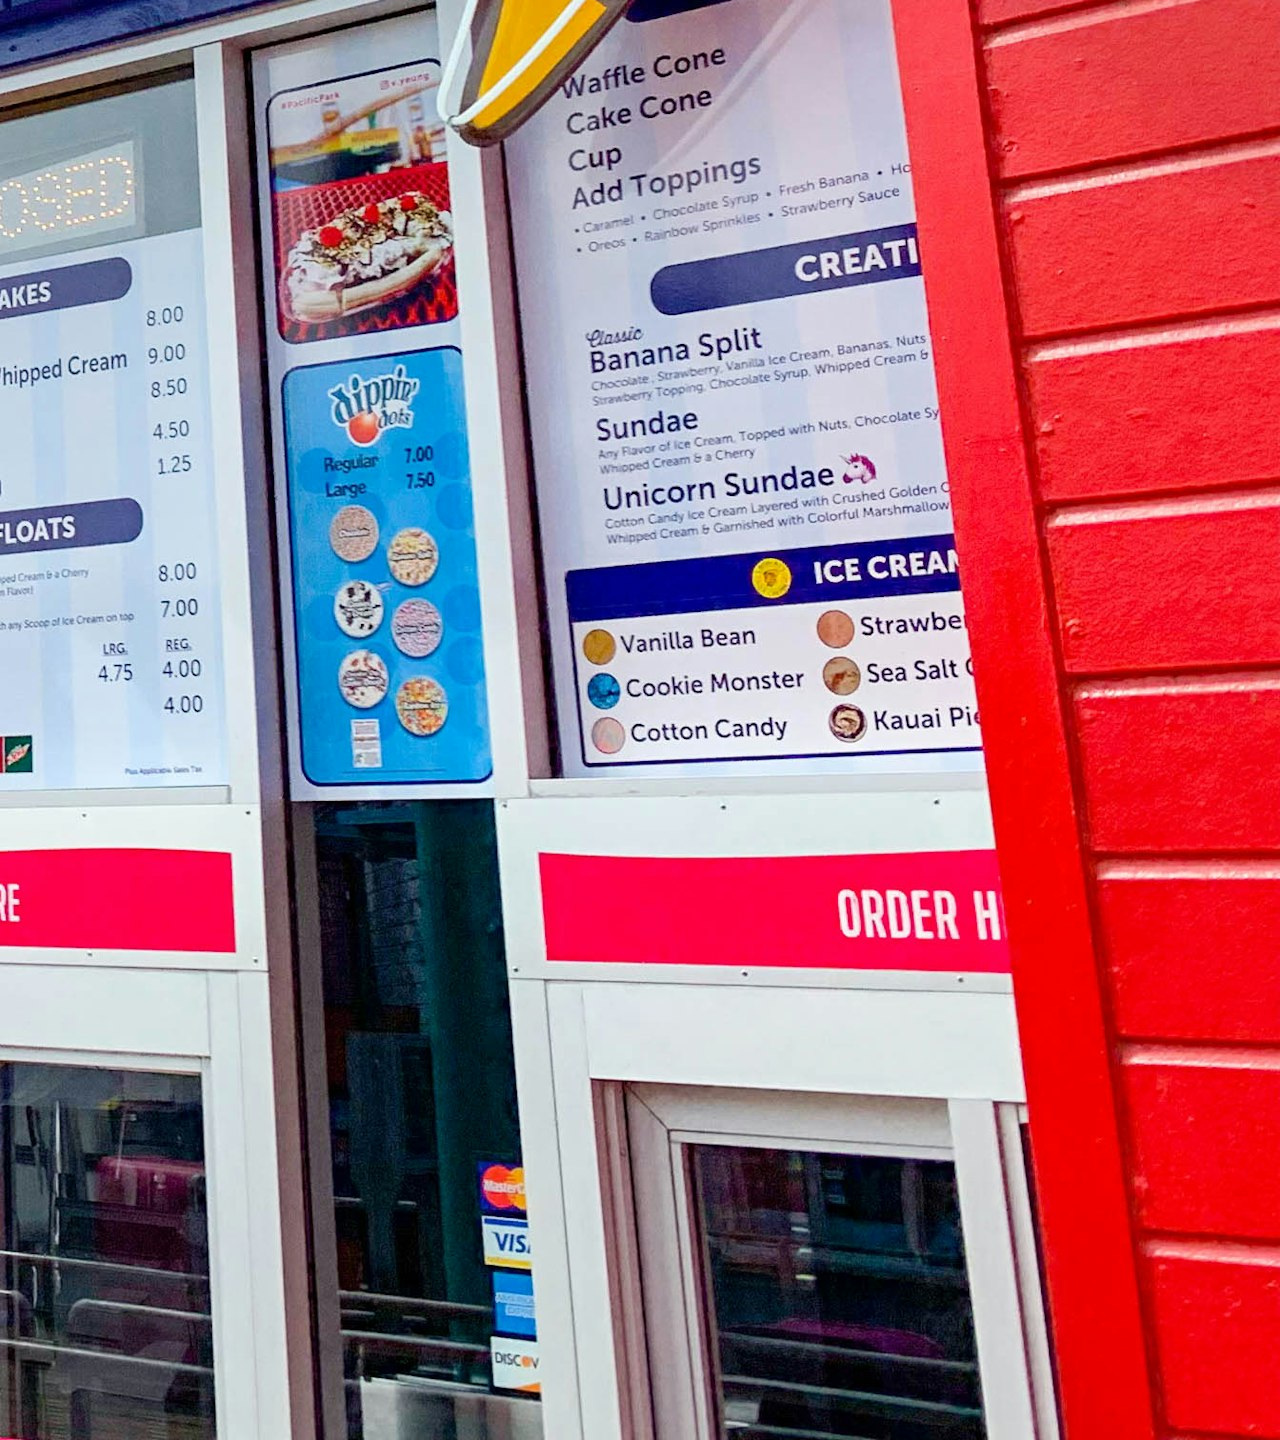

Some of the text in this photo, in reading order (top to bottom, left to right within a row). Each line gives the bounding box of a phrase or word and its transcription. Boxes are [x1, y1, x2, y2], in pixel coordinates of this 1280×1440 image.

[562, 47, 727, 99] Waffle Cone
[566, 88, 713, 135] Cake Cone
[568, 146, 622, 173] Cup
[572, 157, 762, 210] Add Toppings
[652, 198, 718, 220] Chocolate
[722, 191, 759, 209] Syrup
[779, 179, 815, 196] Fresh
[818, 170, 870, 189] Banana
[781, 186, 900, 218] Strawberry Sauce
[146, 306, 184, 327] 8.00
[585, 327, 644, 346] Classic
[147, 344, 186, 364] 9.00
[589, 327, 762, 374] Banana Split
[67, 351, 128, 378] Cream
[151, 378, 188, 398] 8.50
[153, 420, 190, 441] 4.50
[596, 410, 699, 441] Sundae
[157, 454, 192, 475] 1.25
[324, 445, 433, 473] Regular 7.00
[599, 460, 650, 477] Whipped
[652, 454, 691, 469] Cream
[715, 447, 756, 463] Cherry
[325, 472, 435, 498] Large 7.50
[603, 466, 834, 511] Unicorn Sundae
[158, 562, 197, 583] 8.00
[814, 557, 861, 584] ICE
[161, 597, 198, 618] 7.00
[620, 612, 966, 654] Vanilla Bean Strawbe
[98, 659, 202, 683] 4.75 4.00
[626, 659, 957, 698] Cookie Monster Sea Salt
[164, 694, 203, 714] 4.00
[630, 721, 708, 743] Cotton
[714, 718, 788, 741] Candy
[873, 709, 941, 732] Kauai
[839, 888, 959, 941] ORDER
